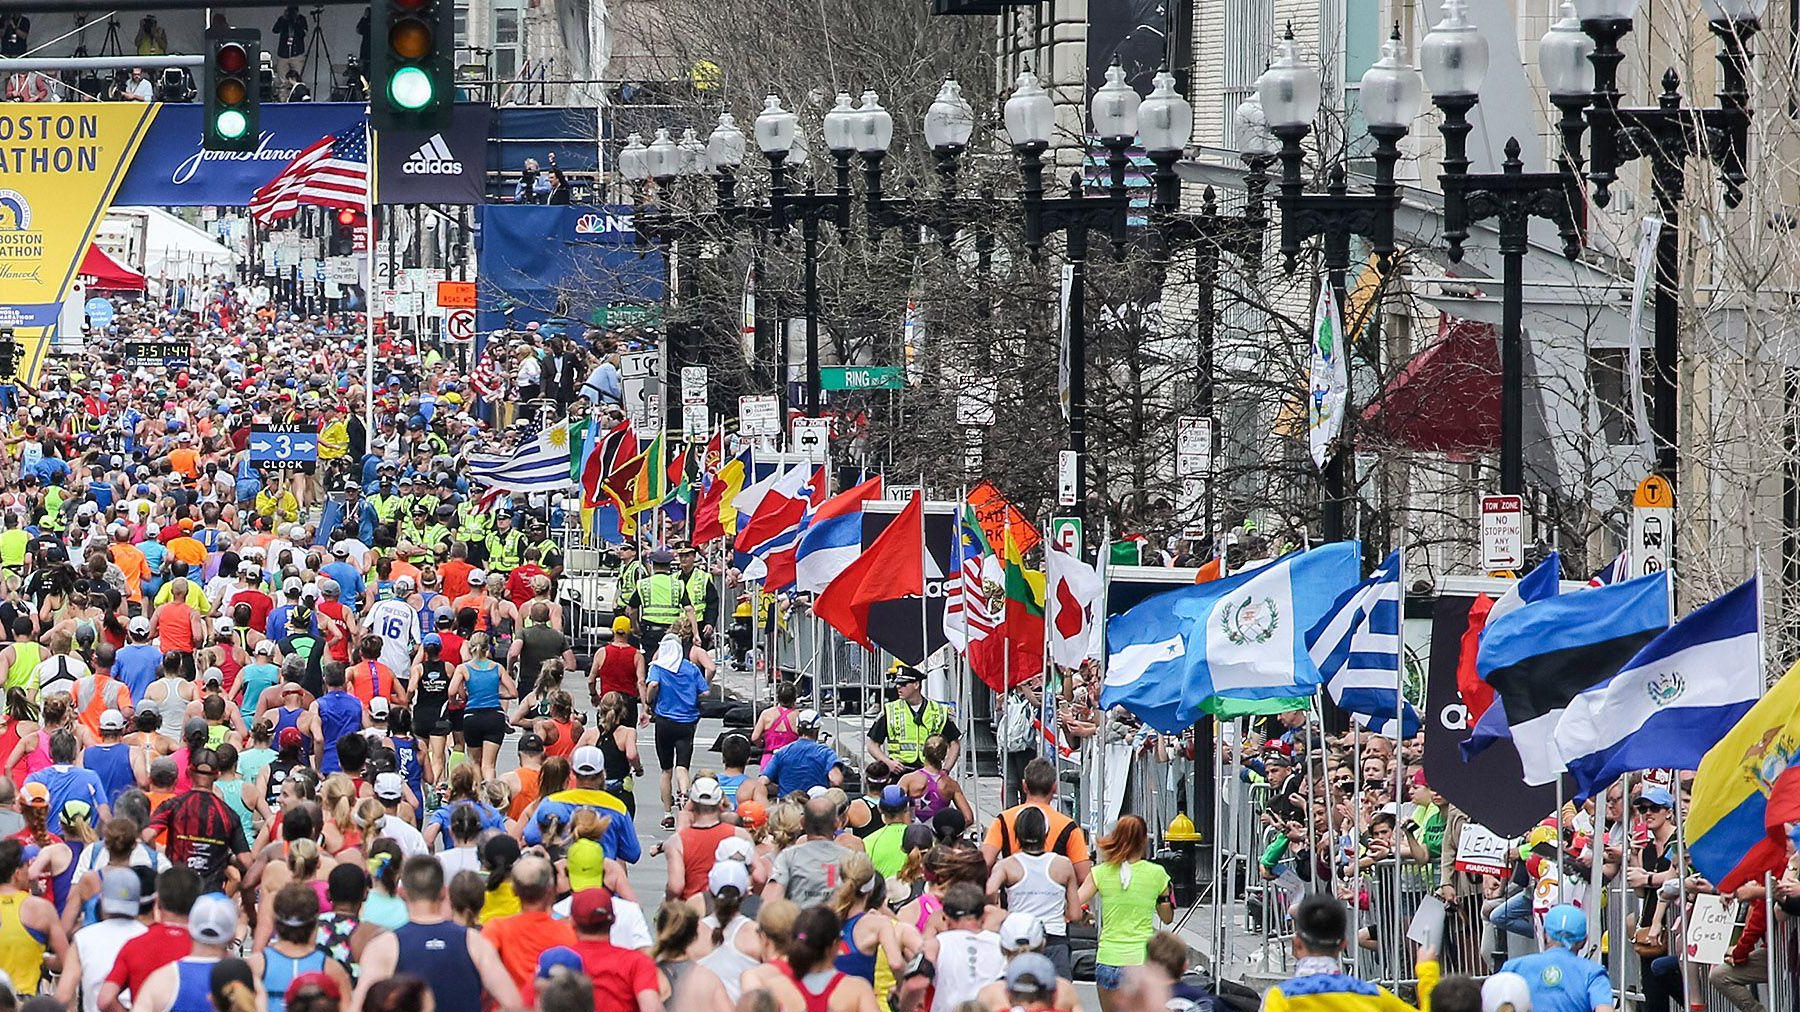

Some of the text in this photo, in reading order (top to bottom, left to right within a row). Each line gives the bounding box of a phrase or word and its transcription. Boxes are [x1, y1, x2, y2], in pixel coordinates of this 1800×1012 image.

[402, 159, 463, 175] adidas
[137, 345, 189, 356] 3:51:44
[845, 371, 870, 387] RING
[268, 424, 300, 433] WAVE
[275, 434, 292, 459] 3
[263, 460, 303, 469] CLOCK
[1647, 485, 1658, 500] T
[1485, 501, 1519, 510] TOW ZONE
[1496, 516, 1508, 525] NO
[1484, 526, 1520, 536] STOPPING
[381, 615, 403, 639] 16
[1703, 905, 1728, 924] Team
